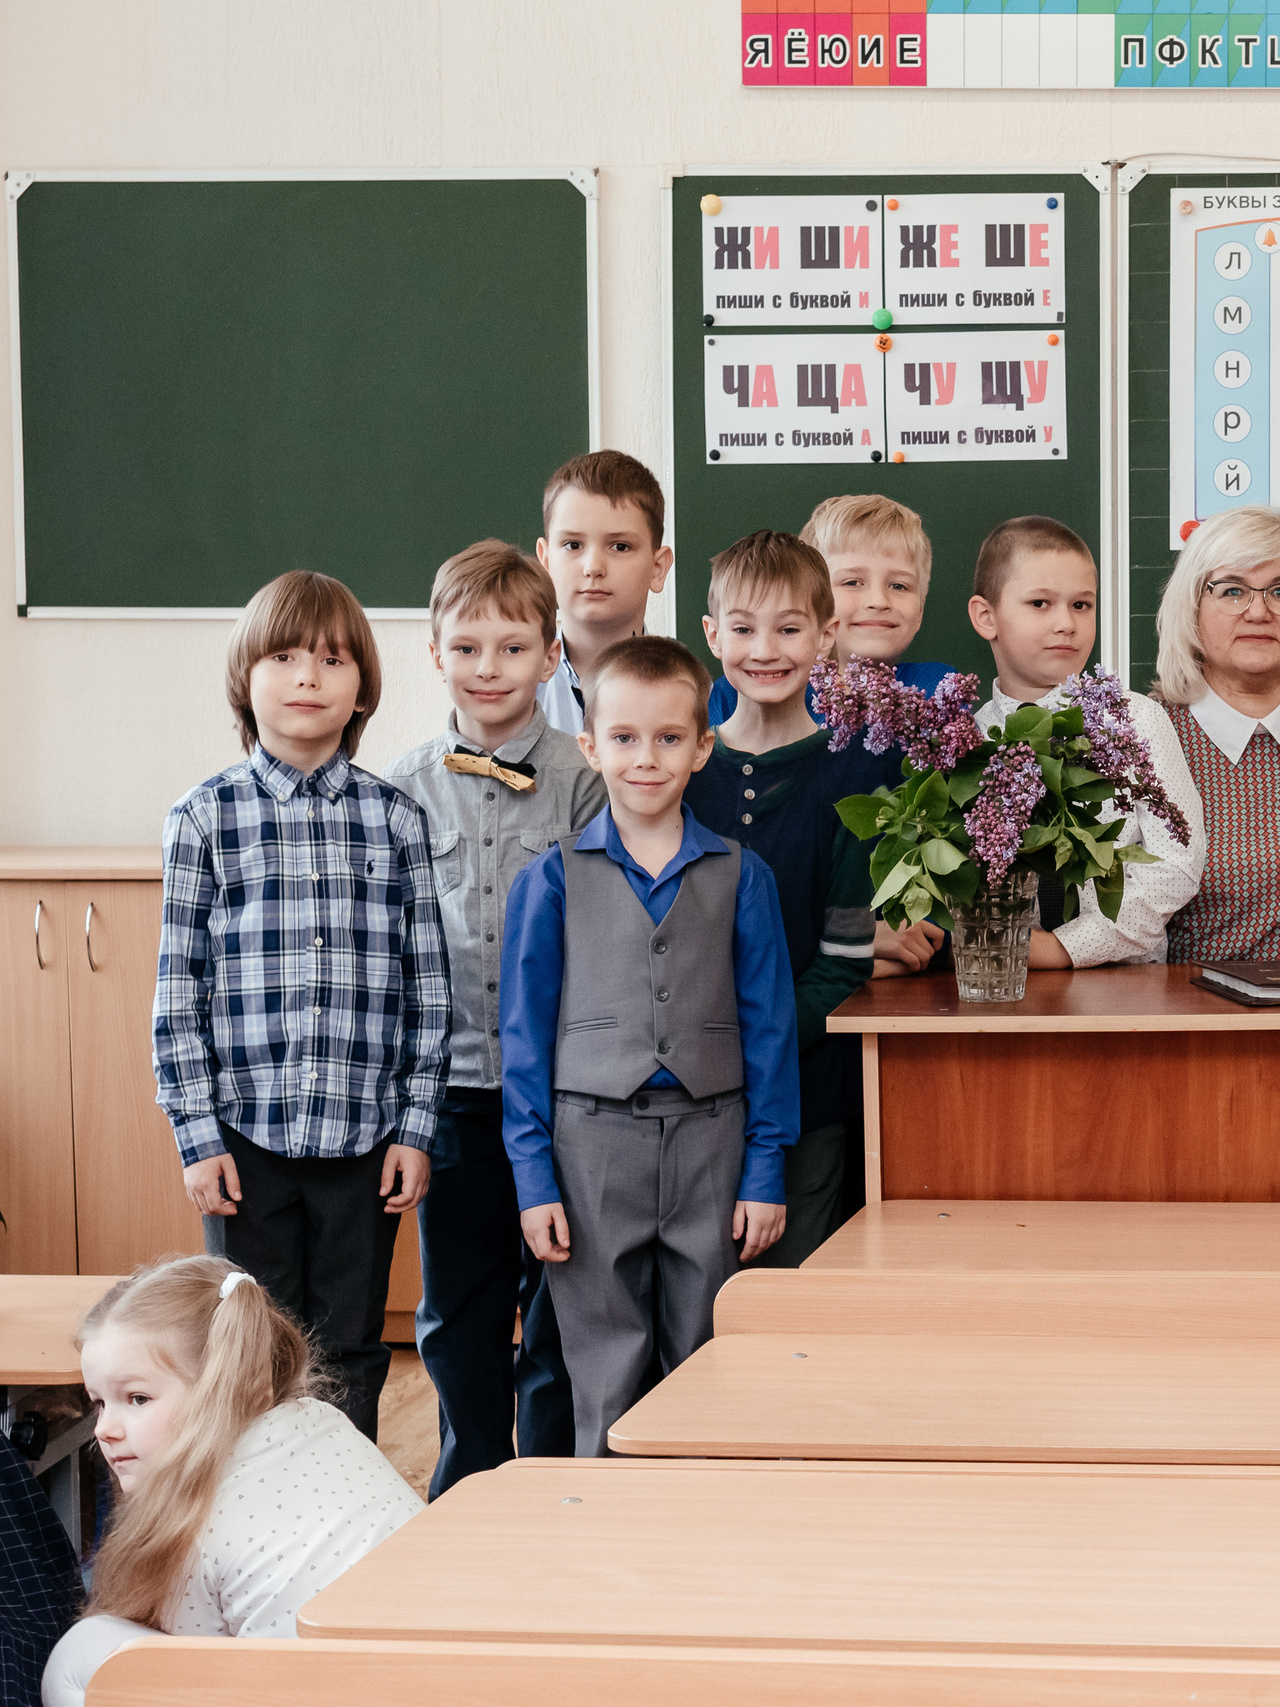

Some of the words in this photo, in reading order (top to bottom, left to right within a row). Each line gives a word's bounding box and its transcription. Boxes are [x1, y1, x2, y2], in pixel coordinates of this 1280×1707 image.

[1203, 195, 1267, 210] БУКВЫ
[713, 226, 780, 270] ЖИ
[799, 225, 870, 270] ШИ
[899, 224, 960, 269] ЖЕ
[984, 223, 1050, 268] ШЕ
[1224, 251, 1241, 270] л
[715, 294, 765, 309] пиши
[772, 294, 782, 309] с
[789, 290, 851, 311] буквой
[858, 290, 870, 309] И
[898, 292, 948, 308] пиши
[955, 292, 965, 307] с
[972, 288, 1035, 309] буквой
[1041, 288, 1052, 307] Е
[722, 364, 779, 408] ЧА
[796, 363, 868, 415] ЩА
[903, 362, 957, 406] ЧУ
[980, 360, 1049, 412] ЩУ
[718, 432, 768, 447] пиши
[774, 432, 785, 447] с
[791, 427, 854, 448] буквой
[860, 428, 873, 447] А
[900, 430, 950, 446] пиши
[957, 429, 968, 445] с
[974, 424, 1037, 446] буквой
[1042, 425, 1054, 444] У
